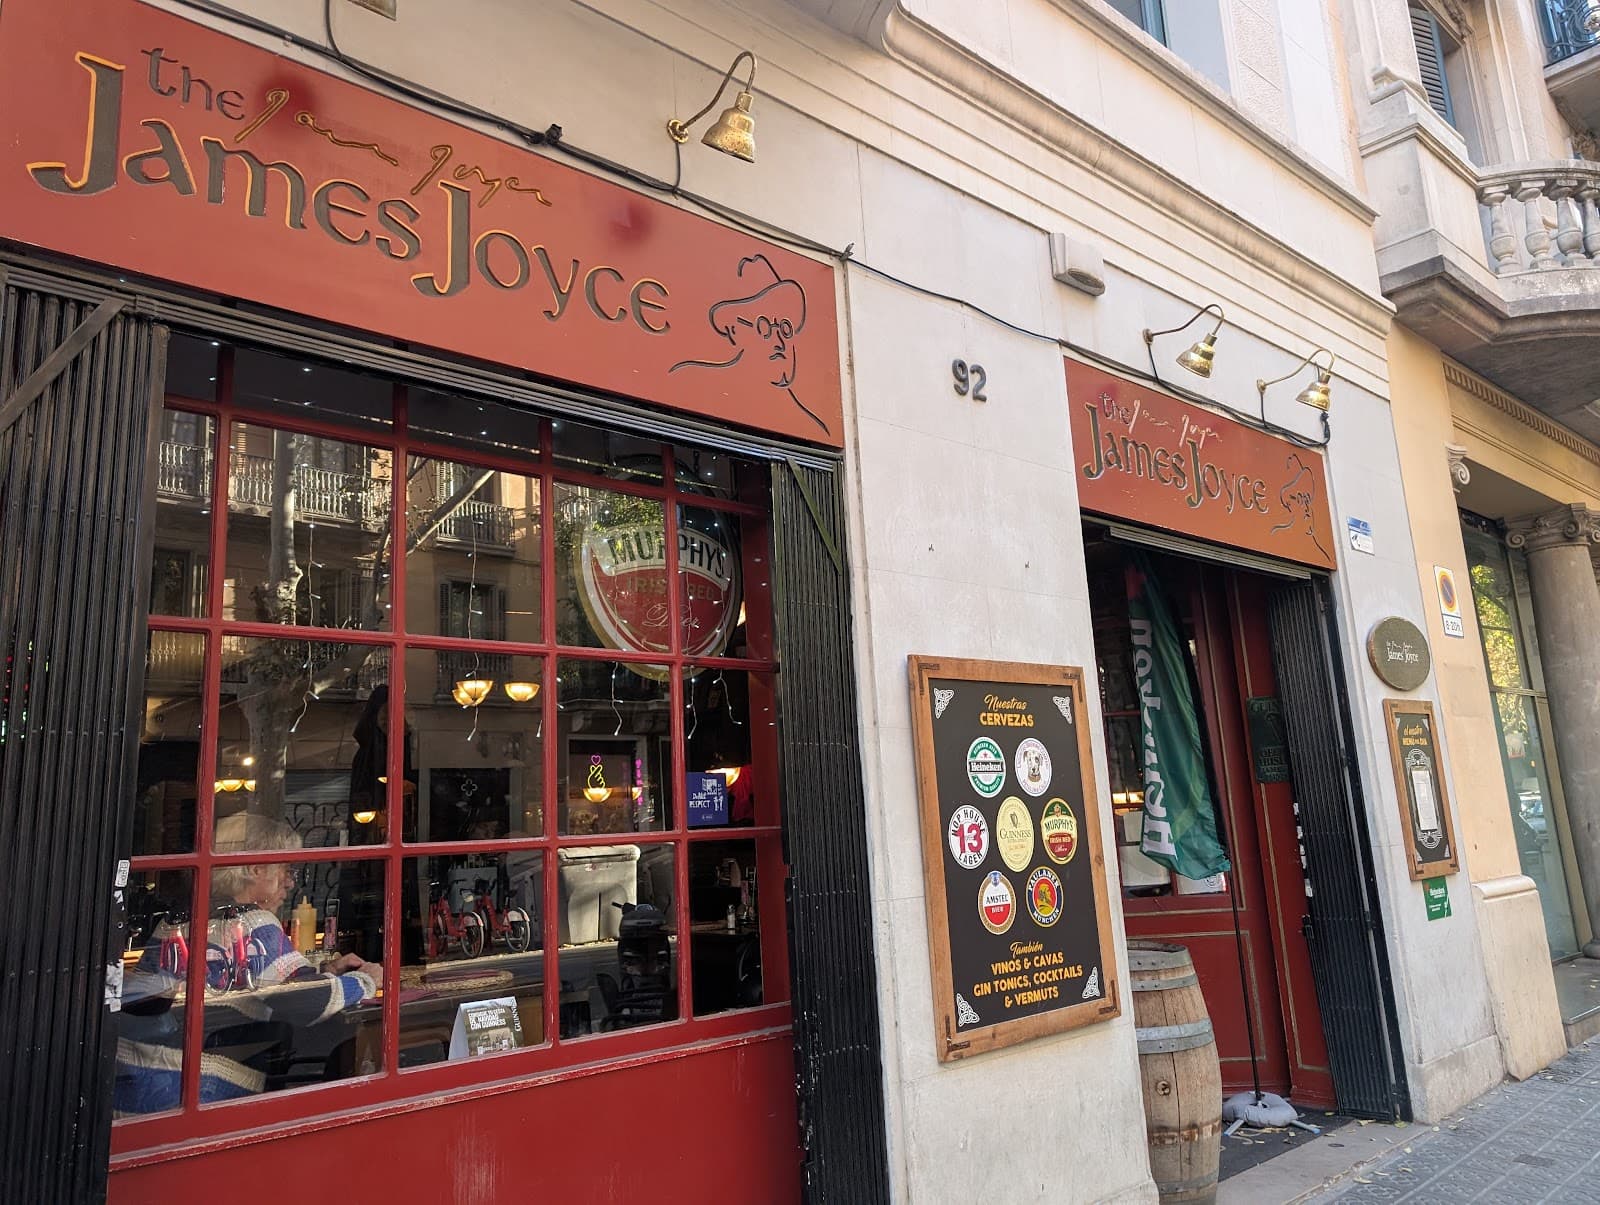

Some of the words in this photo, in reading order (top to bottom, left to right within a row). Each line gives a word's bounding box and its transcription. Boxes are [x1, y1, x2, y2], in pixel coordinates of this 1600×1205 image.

[140, 47, 246, 121] the
[26, 51, 422, 261] James
[410, 179, 671, 334] Joyce
[951, 359, 987, 402] 92
[1082, 403, 1188, 491] James
[1185, 438, 1269, 514] Joyce
[983, 694, 1028, 712] Nuestras
[980, 711, 1035, 728] CERVEZAS
[971, 761, 1002, 773] Heineken
[951, 813, 962, 837] HOP
[963, 808, 986, 835] HOUSE
[1000, 828, 1032, 840] GUINNESS
[956, 823, 983, 854] 13
[958, 852, 983, 866] LAGER
[1028, 869, 1060, 892] PAULANER
[985, 894, 1009, 905] AMSTEL
[1009, 941, 1044, 959] También
[991, 959, 1021, 975] VINOS
[1023, 958, 1031, 970] &
[1033, 952, 1064, 968] CAVAS
[973, 982, 992, 997] GIN
[993, 975, 1032, 993] TONICS,
[1033, 965, 1083, 985] COCKTAILS
[1004, 996, 1013, 1008] &
[1014, 986, 1059, 1006] VERMUTS
